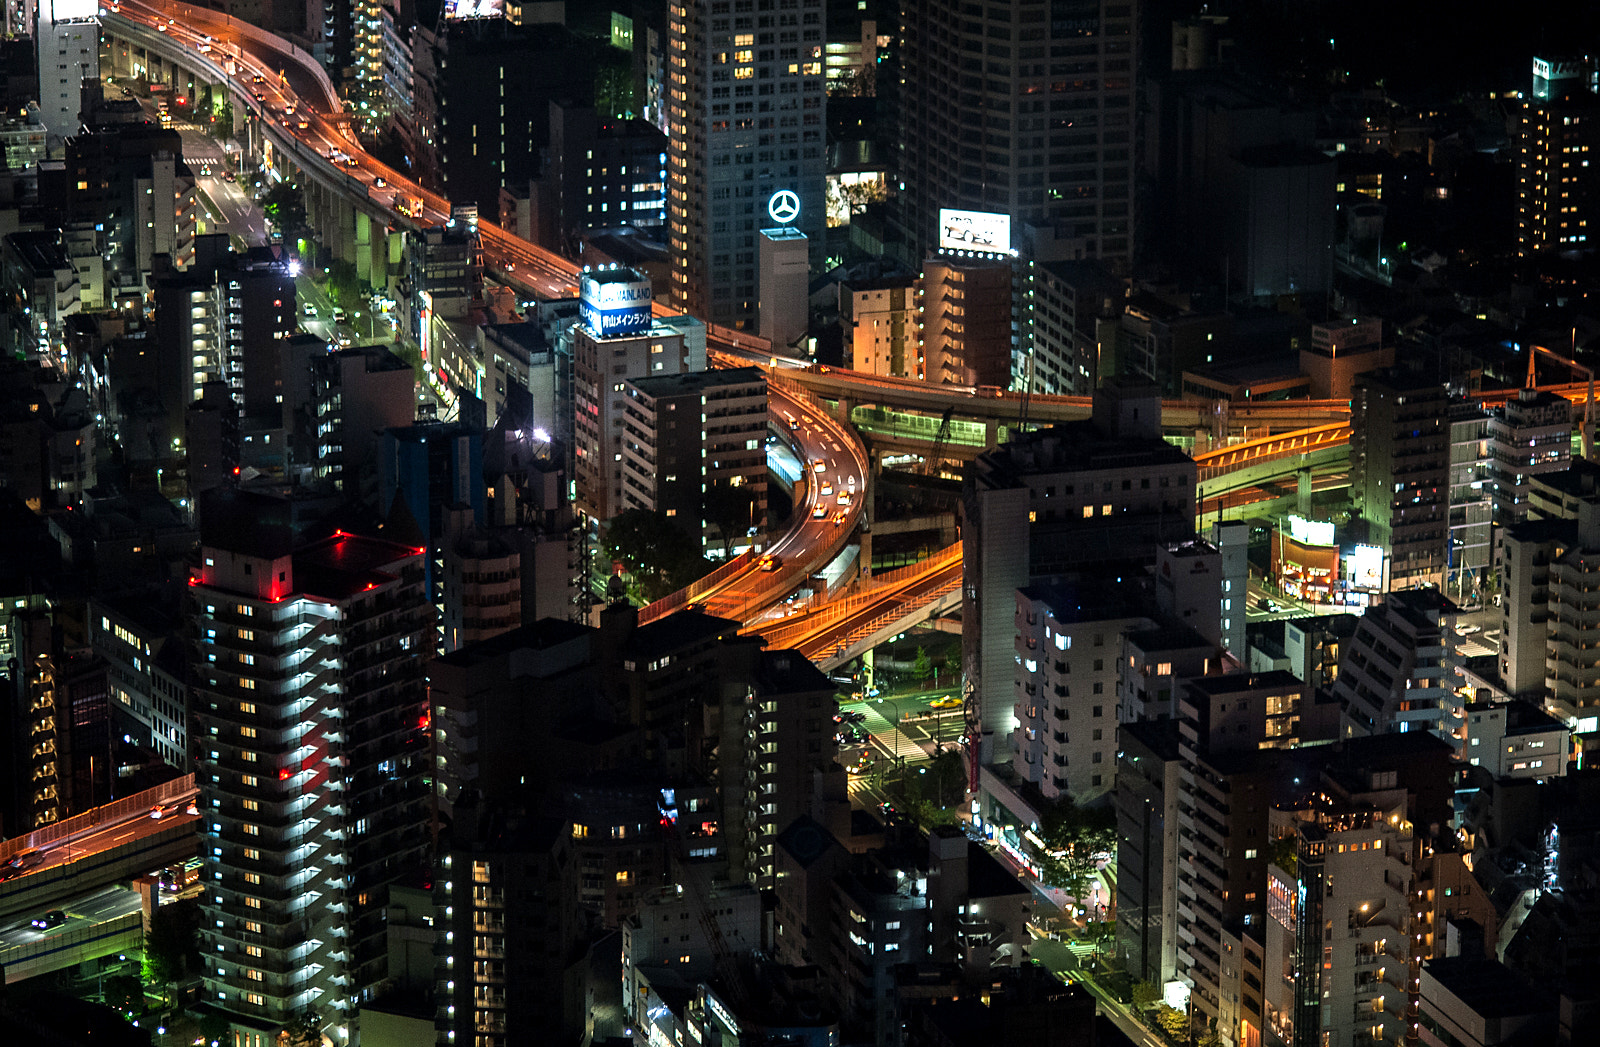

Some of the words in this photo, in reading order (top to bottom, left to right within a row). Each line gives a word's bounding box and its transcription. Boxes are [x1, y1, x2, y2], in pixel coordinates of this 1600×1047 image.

[602, 312, 651, 328] 青山メインランド
